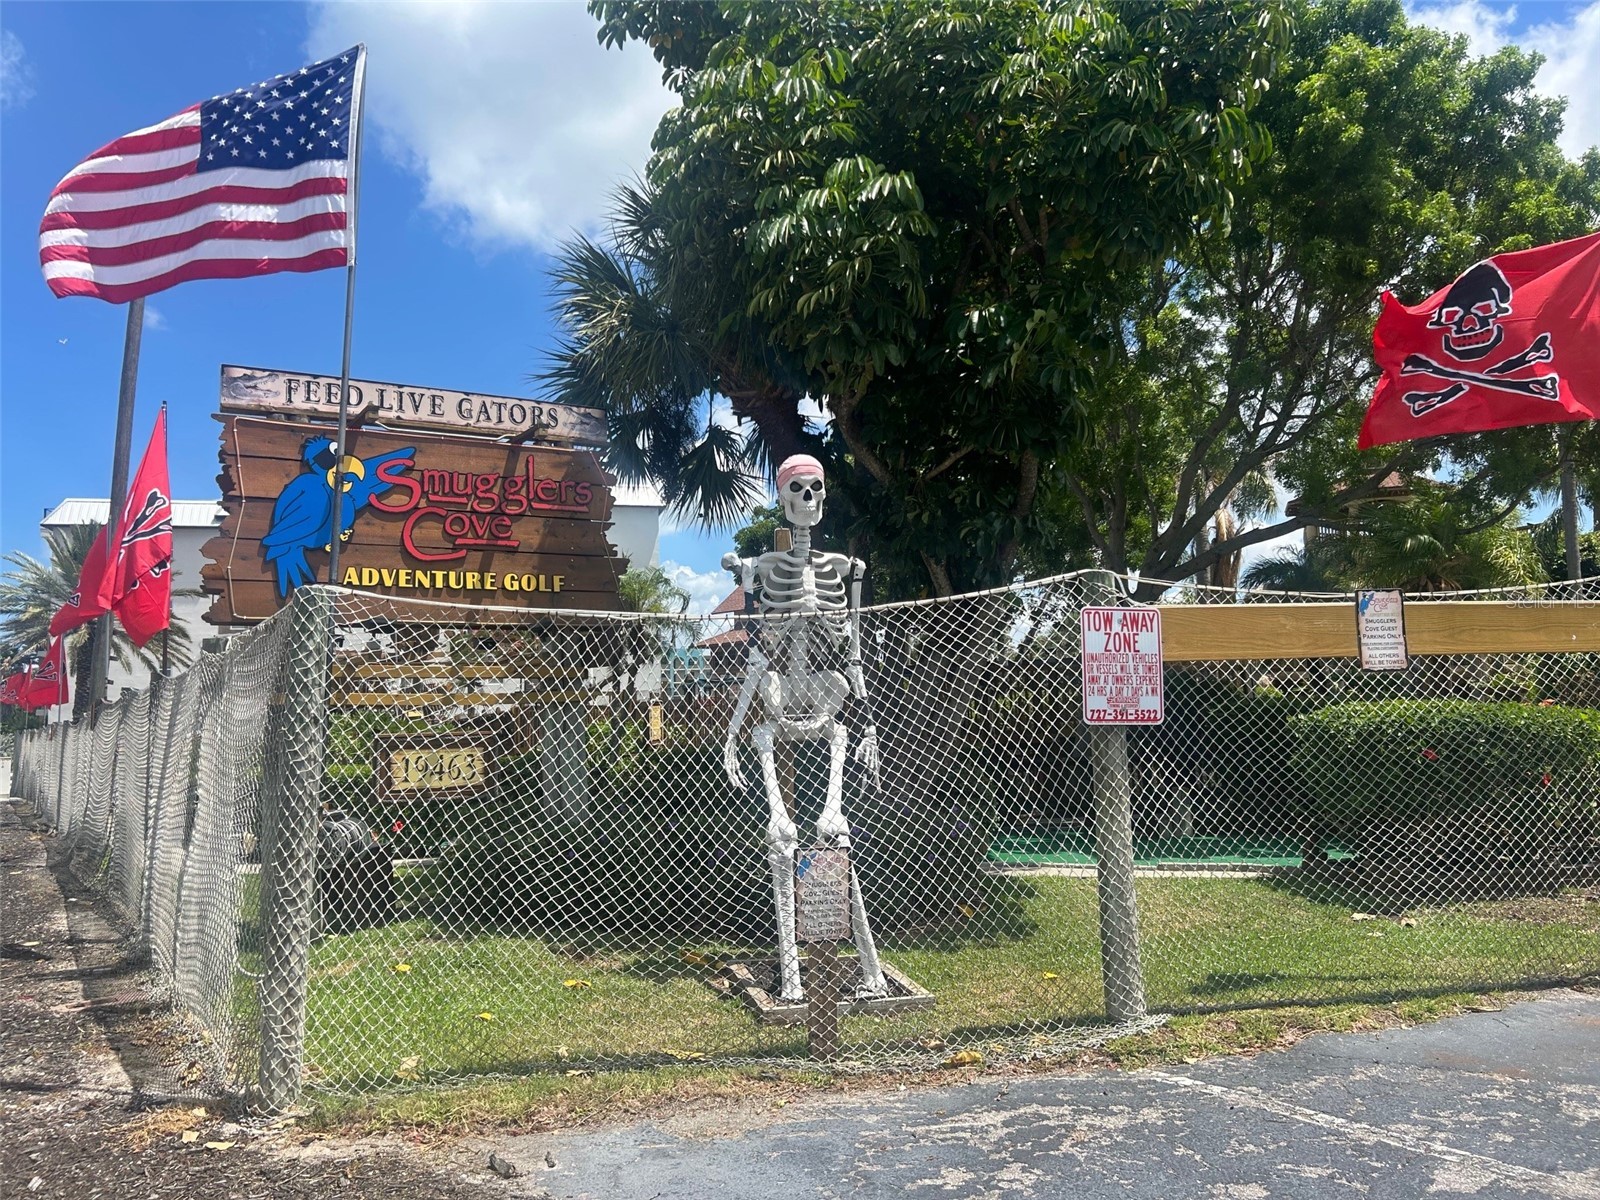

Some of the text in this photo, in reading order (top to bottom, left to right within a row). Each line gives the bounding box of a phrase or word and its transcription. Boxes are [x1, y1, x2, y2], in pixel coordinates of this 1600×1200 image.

[283, 378, 559, 428] FEED LIVE GATORS
[368, 455, 593, 515] Smugglers
[402, 506, 515, 561] Cove
[343, 566, 565, 592] ADVENTURE GOLF
[1085, 611, 1156, 633] TOW AWAY
[1104, 632, 1140, 653] ZONE
[1086, 653, 1159, 664] UNAUTHORIZED VEHICLES
[1086, 664, 1159, 675] OR VESSELS WILL BE TOWED
[1087, 675, 1159, 686] AWAY AT OWNERS EXPENSE
[1088, 686, 1159, 697] 24 HRS A DAY 7 DAYS A WK
[1090, 709, 1158, 720] 727-391-5522
[401, 753, 477, 783] 19463
